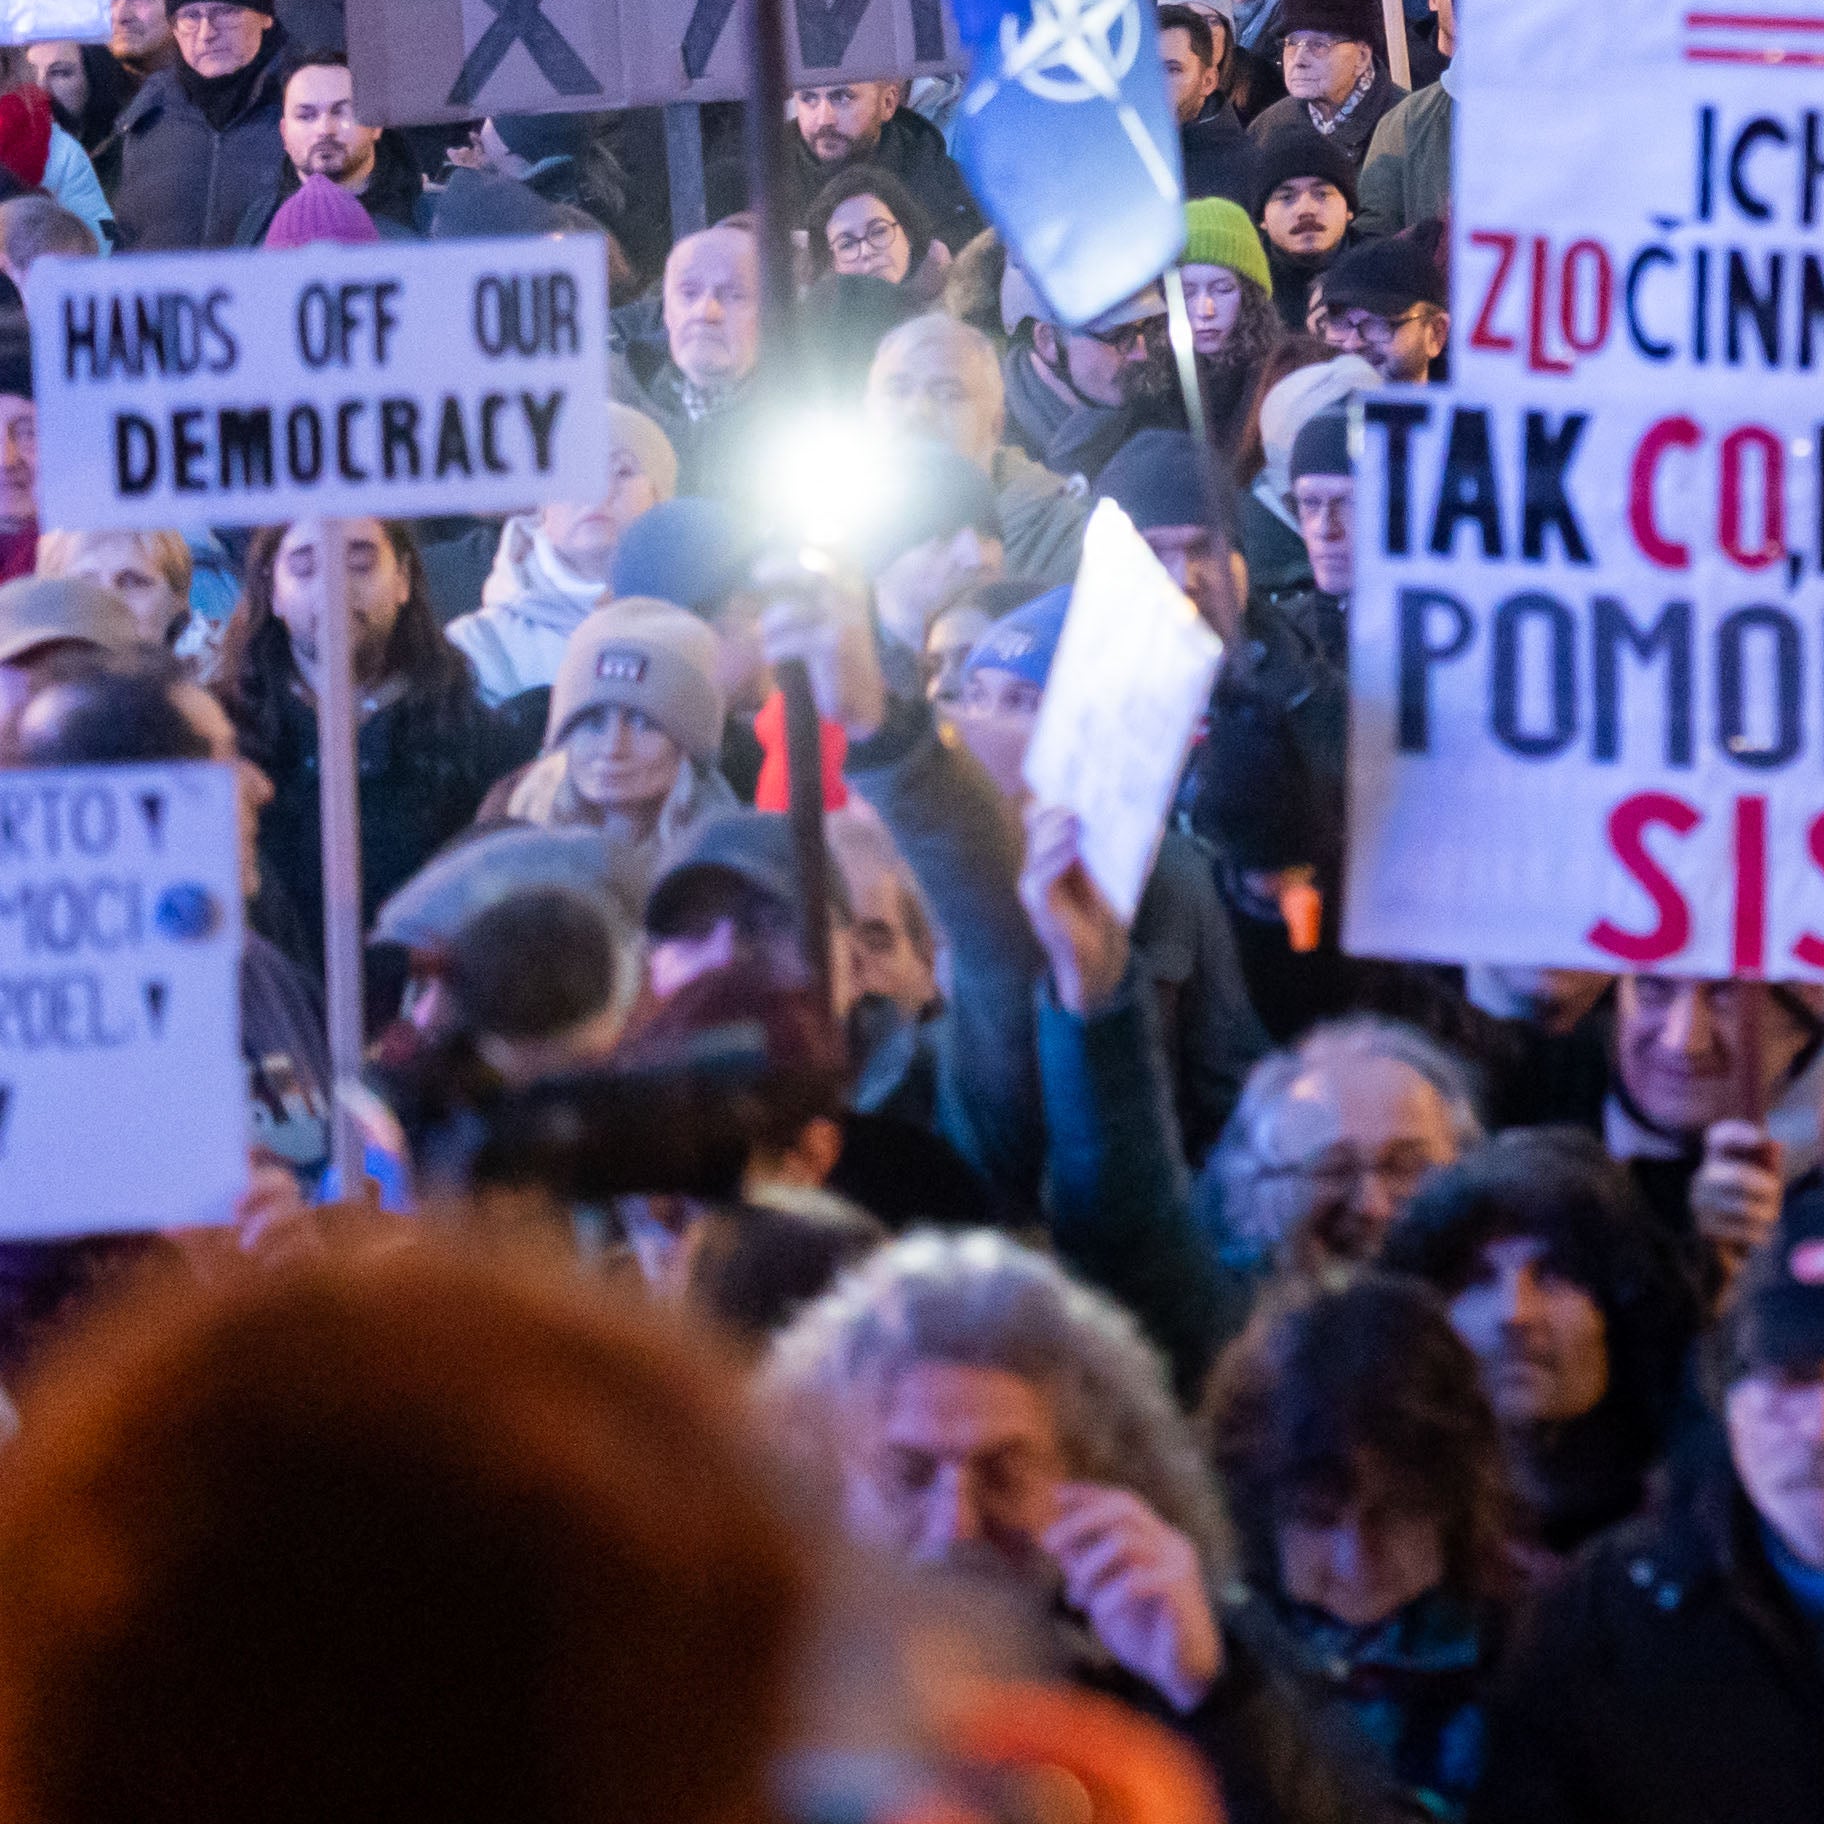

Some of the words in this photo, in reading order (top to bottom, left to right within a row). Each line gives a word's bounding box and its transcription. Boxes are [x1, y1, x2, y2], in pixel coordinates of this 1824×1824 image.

[62, 291, 240, 380] HANDS
[295, 282, 406, 368] OFF
[473, 272, 580, 356] OUR
[114, 391, 567, 498] DEMOCRACY
[1364, 400, 1592, 566] TAK
